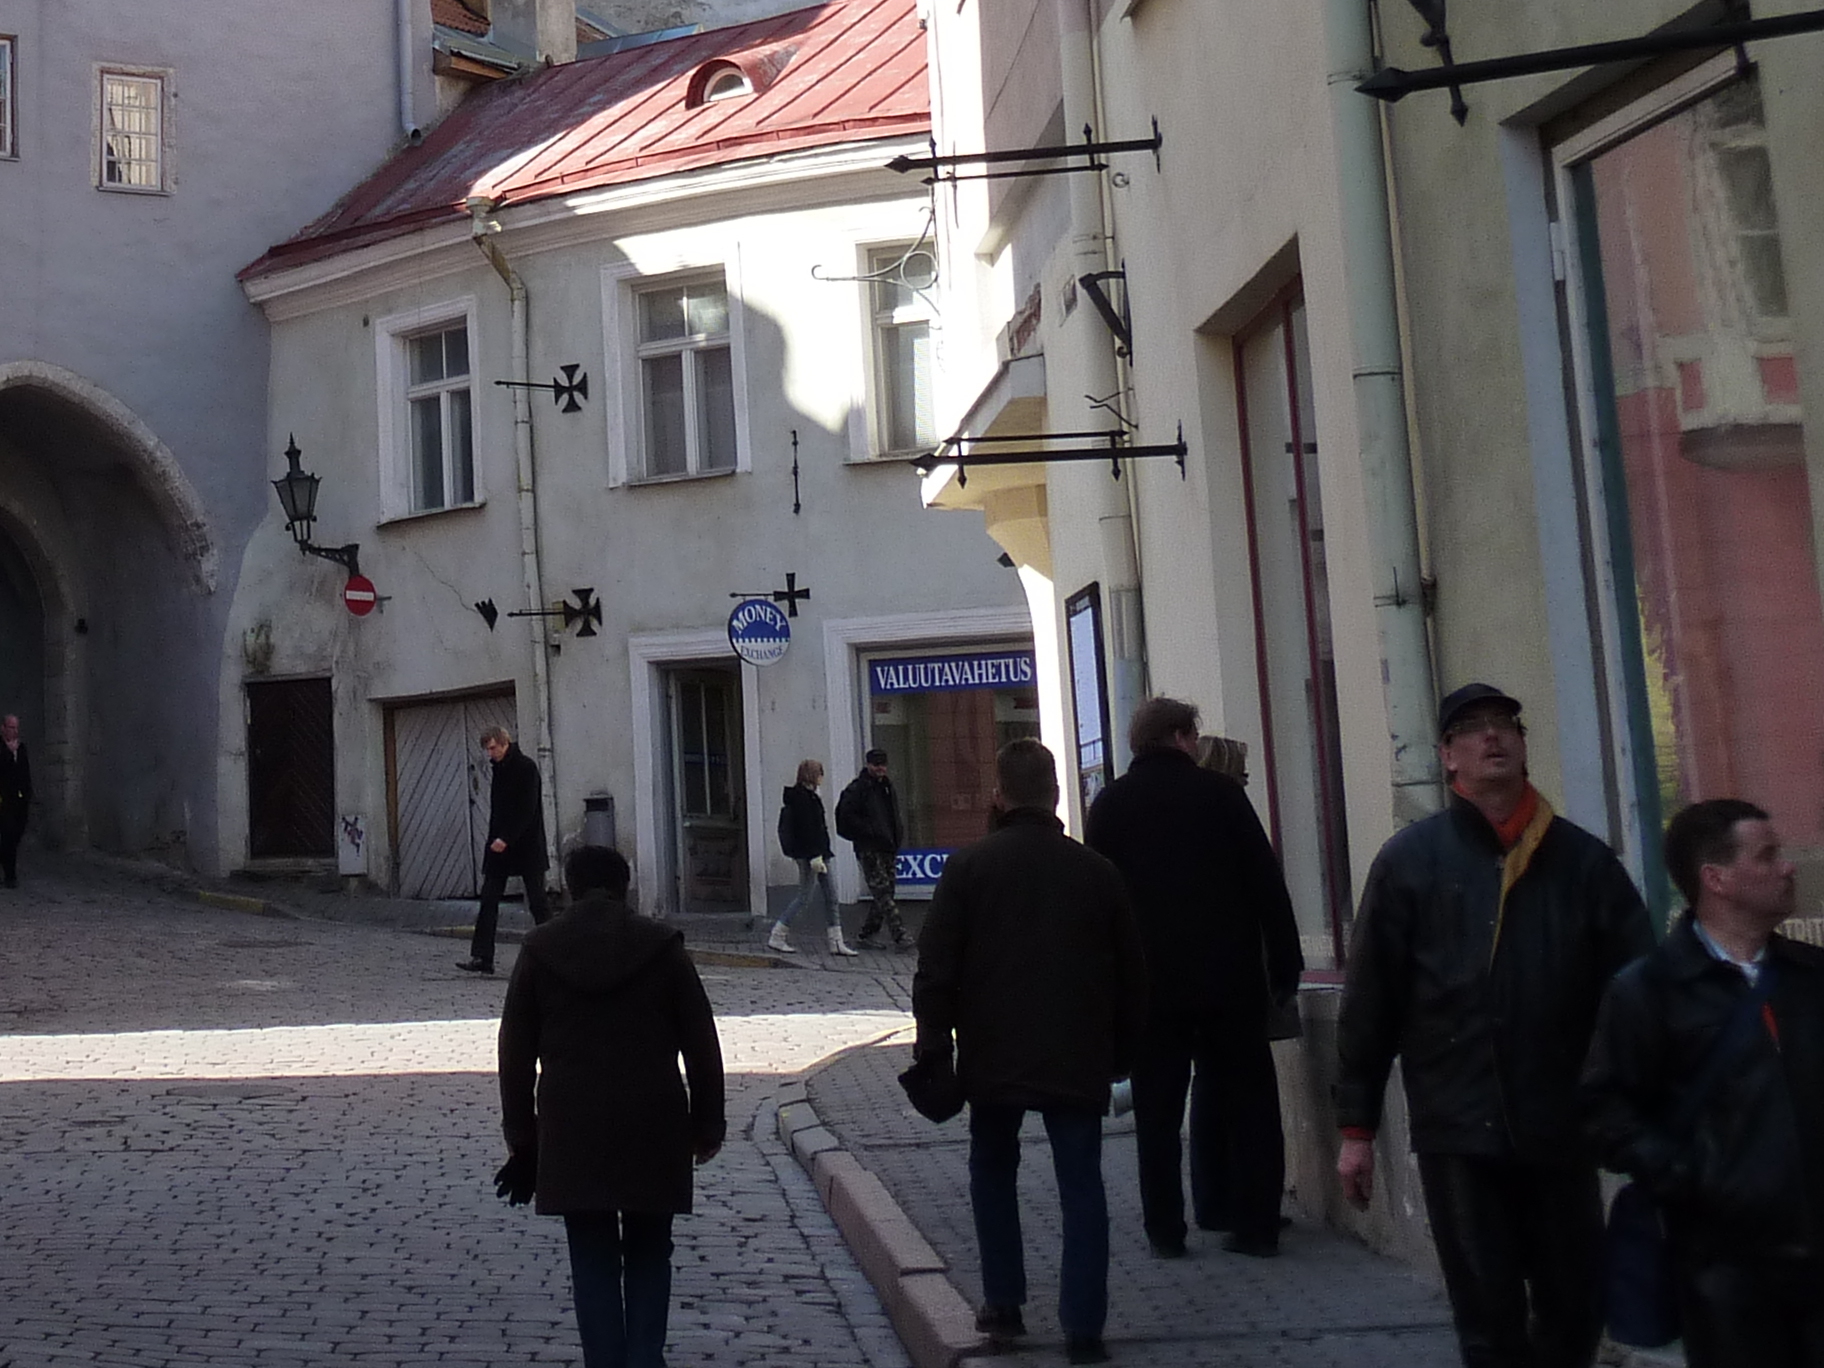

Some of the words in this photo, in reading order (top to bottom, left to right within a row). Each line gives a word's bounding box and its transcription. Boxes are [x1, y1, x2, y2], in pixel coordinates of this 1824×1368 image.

[732, 604, 786, 635] MONEY
[740, 645, 784, 660] EXCHANGE
[875, 657, 1032, 690] VALUUTAVAHETUS
